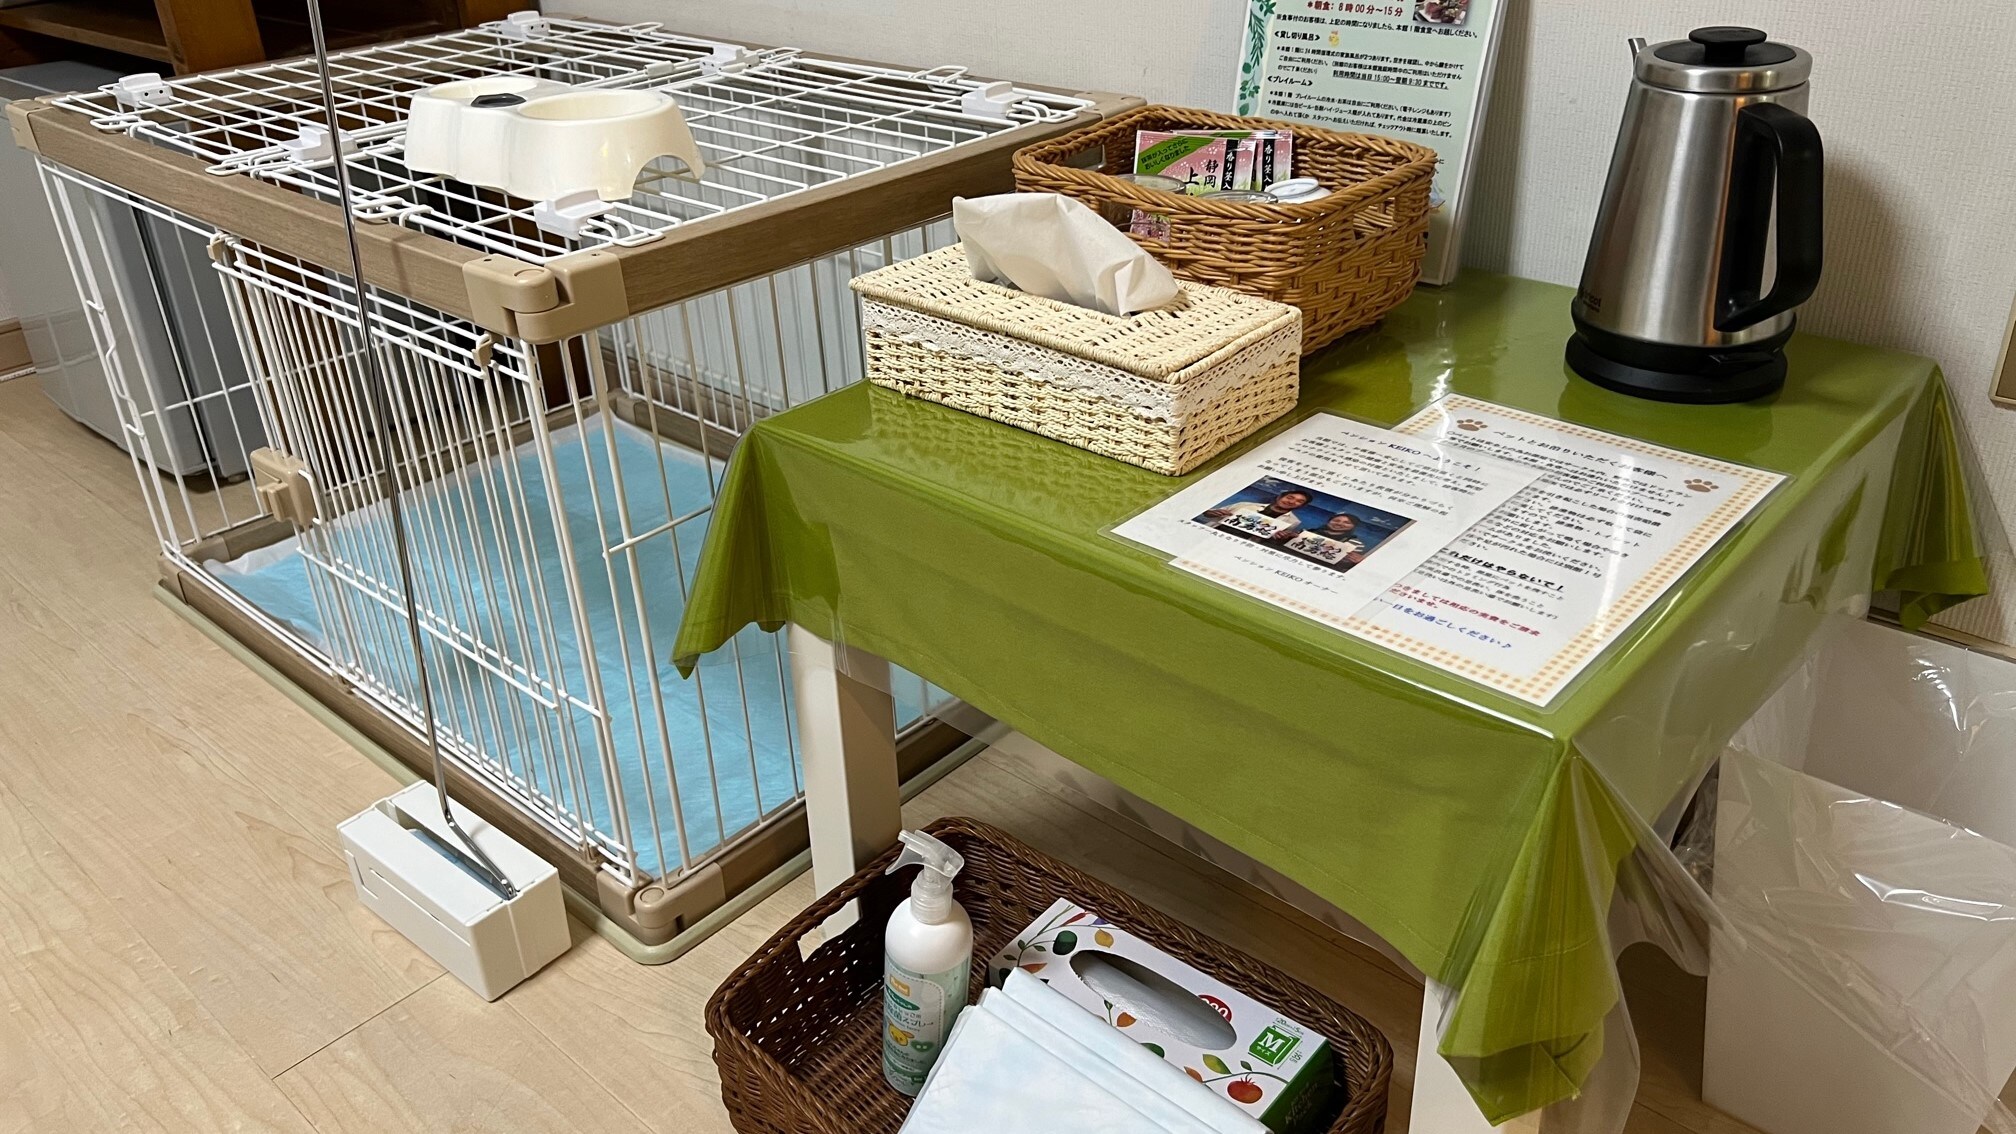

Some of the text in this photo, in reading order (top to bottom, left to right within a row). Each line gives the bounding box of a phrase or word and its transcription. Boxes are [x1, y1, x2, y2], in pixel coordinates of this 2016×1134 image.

[1203, 159, 1219, 188] 静岡
[1386, 443, 1422, 455] KEIKO
[1273, 569, 1305, 582] KEIKO
[1257, 1031, 1285, 1053] M
